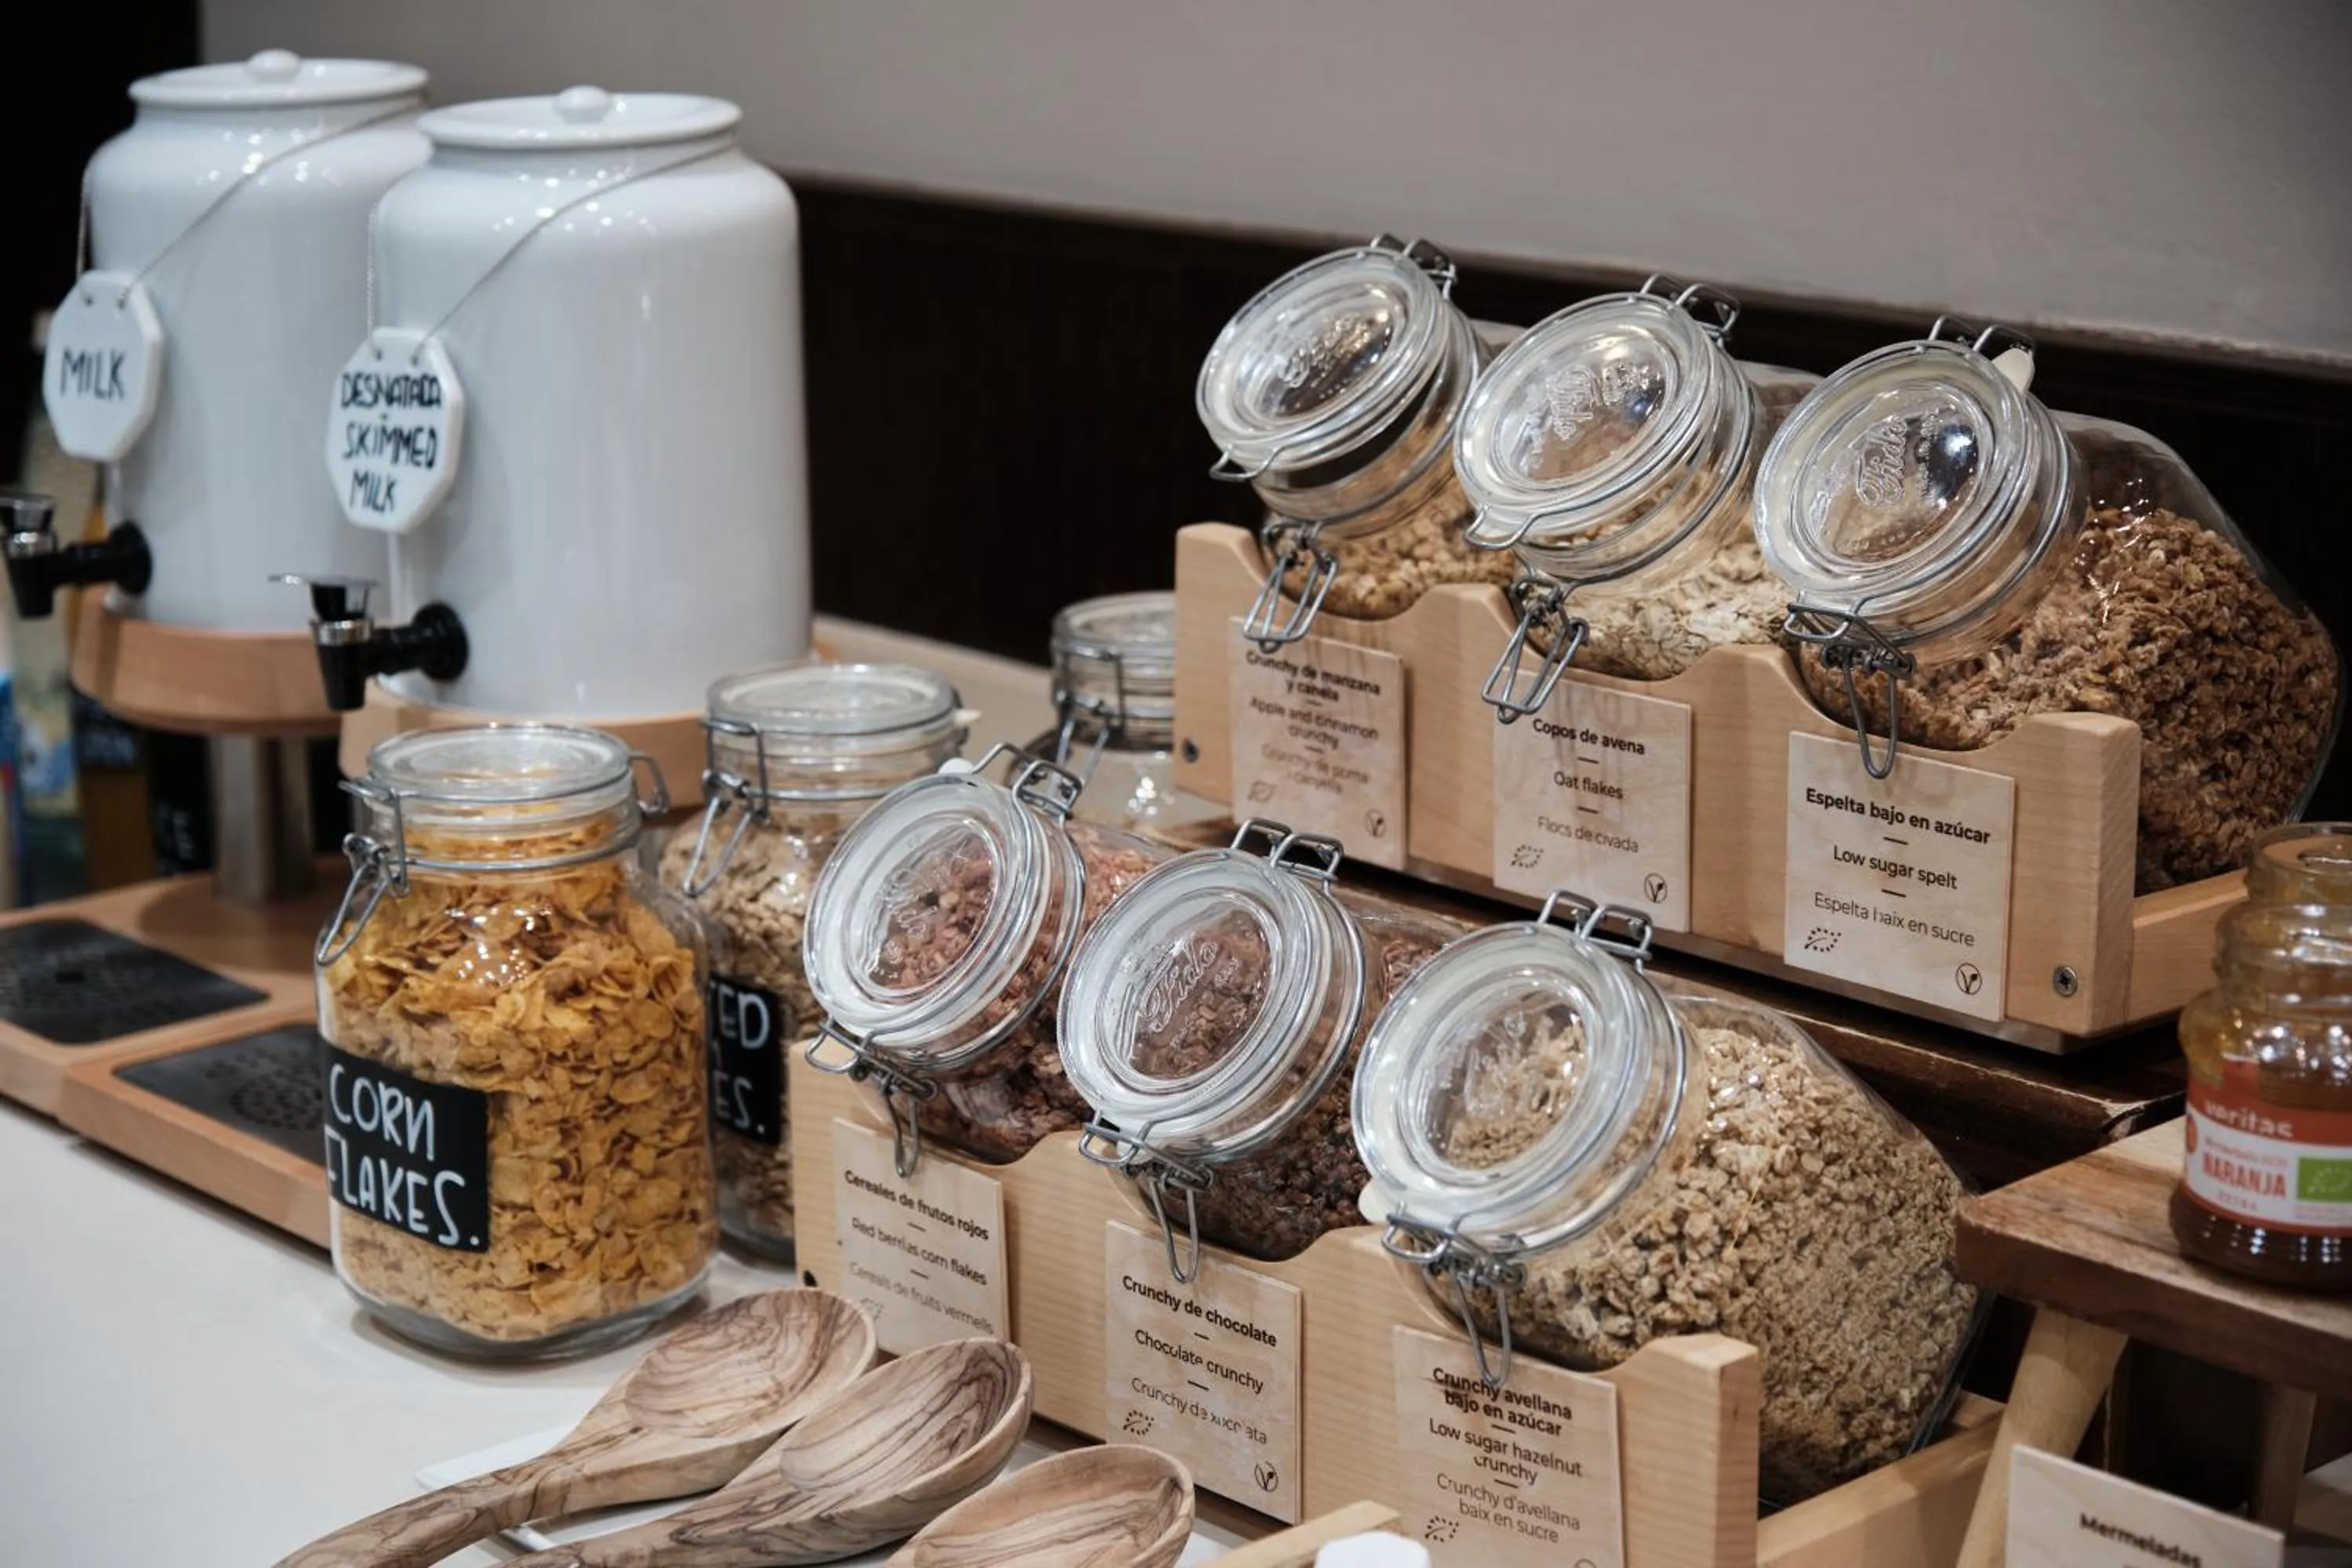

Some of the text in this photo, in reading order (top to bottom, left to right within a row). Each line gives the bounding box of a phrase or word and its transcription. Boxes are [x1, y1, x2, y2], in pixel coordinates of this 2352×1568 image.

[60, 346, 125, 401] MILK
[341, 372, 442, 408] DESNATADA
[343, 422, 438, 469] SKIMMED
[350, 470, 397, 512] MILK
[1246, 650, 1381, 695] Crunchy de manzana
[1286, 678, 1294, 693] y
[1288, 708, 1312, 723] and
[1314, 713, 1378, 740] cinnamon
[1533, 718, 1645, 755] Copos de avena
[1554, 771, 1624, 800] Oat flakes
[1537, 815, 1639, 853] Flocs de civada
[1806, 787, 1991, 844] Espelta bajo en azúcar
[1833, 844, 1958, 890] Low sugar spelt
[1814, 891, 1869, 921] Espelta
[1907, 918, 1929, 935] en
[1931, 924, 1975, 946] sucre
[330, 1064, 434, 1161] CORN
[2203, 1099, 2294, 1138] veritas
[324, 1123, 480, 1245] FLAKES.
[2203, 1151, 2287, 1200] NARANJA
[844, 1170, 989, 1241] Cereales de frutos rojos
[852, 1217, 876, 1239] Red
[920, 1248, 949, 1268] corn
[951, 1257, 988, 1286] flakes
[1122, 1275, 1278, 1348] Crunchy de chocolate
[1134, 1328, 1264, 1395] Chocolate crunchy
[1131, 1377, 1188, 1414] Crunchy
[1189, 1401, 1208, 1420] de
[1432, 1367, 1572, 1421] Crunchy avellana
[1444, 1389, 1563, 1437] bajo en azúcar
[1429, 1417, 1583, 1477] Low sugar hazelnut
[1473, 1455, 1538, 1487] crunchy
[1436, 1472, 1581, 1530] Crunchy d'avellana
[1459, 1498, 1560, 1544] baix en sucre
[2079, 1512, 2202, 1568] Mermeladas
